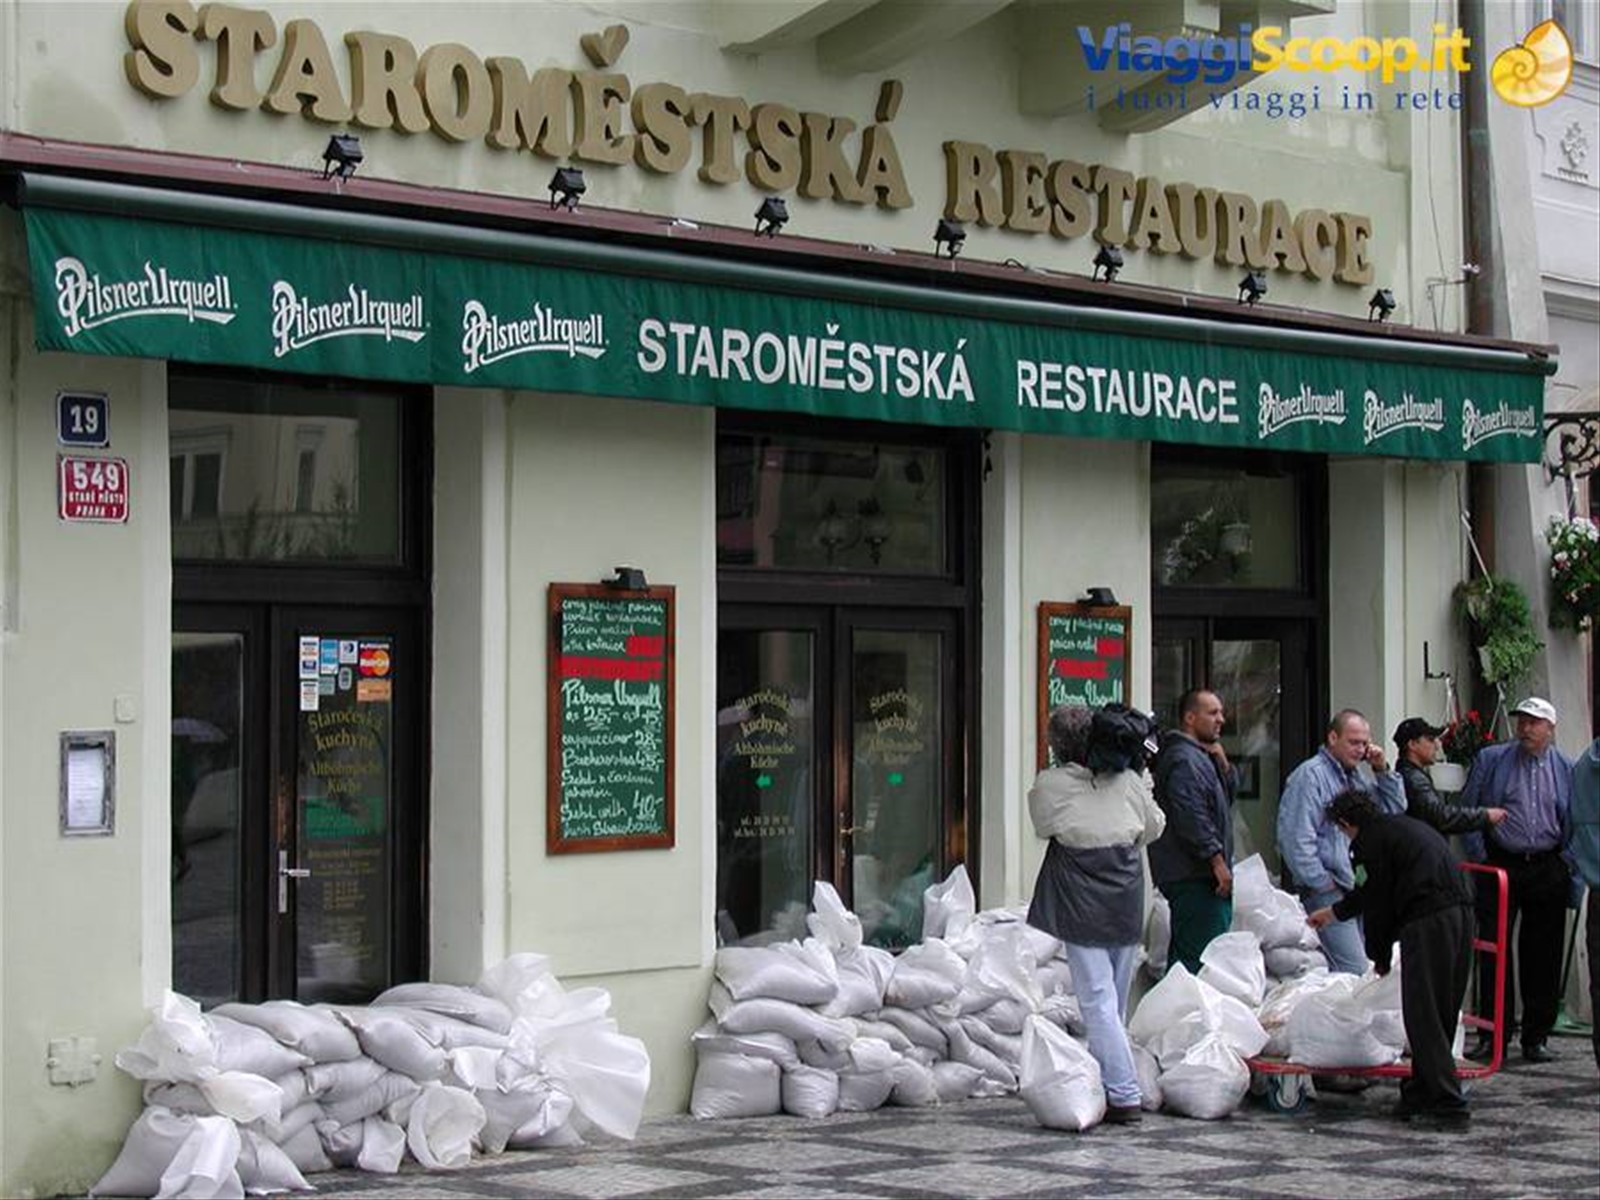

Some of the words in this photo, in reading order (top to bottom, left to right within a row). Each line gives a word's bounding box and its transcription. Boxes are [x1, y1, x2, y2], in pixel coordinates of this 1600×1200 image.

[124, 0, 913, 209] STAROMĚSTSKÁ
[942, 140, 1374, 287] RESTAURACE
[55, 257, 150, 337] Pilsner
[272, 280, 351, 357] Pilsner
[462, 300, 537, 373] Pilsner
[637, 322, 975, 402] STAROMĚSTSKÁ
[1017, 360, 1240, 423] RESTAURACE
[70, 405, 98, 434] 19
[73, 461, 119, 491] 549
